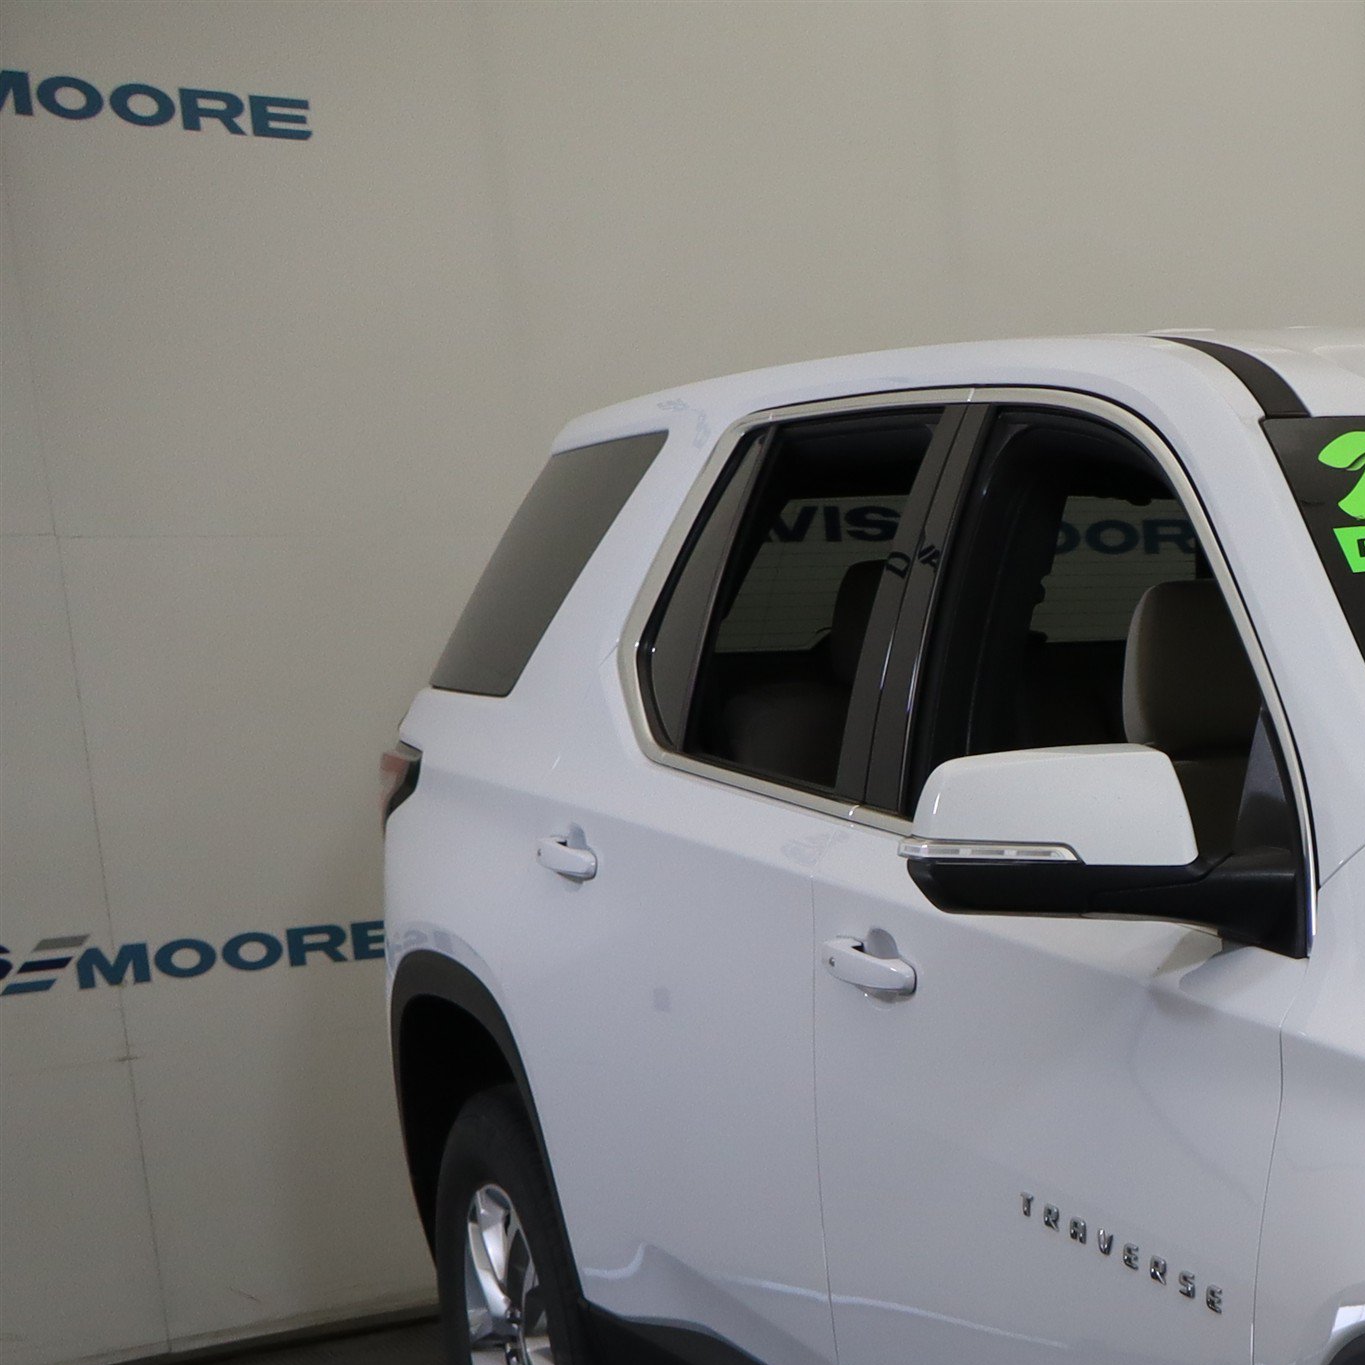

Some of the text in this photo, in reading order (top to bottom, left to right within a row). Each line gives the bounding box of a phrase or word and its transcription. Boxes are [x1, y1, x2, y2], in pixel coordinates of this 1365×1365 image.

[768, 506, 901, 542] VIS
[76, 920, 385, 990] MOORE
[1020, 1192, 1222, 1314] TRAVERSE
